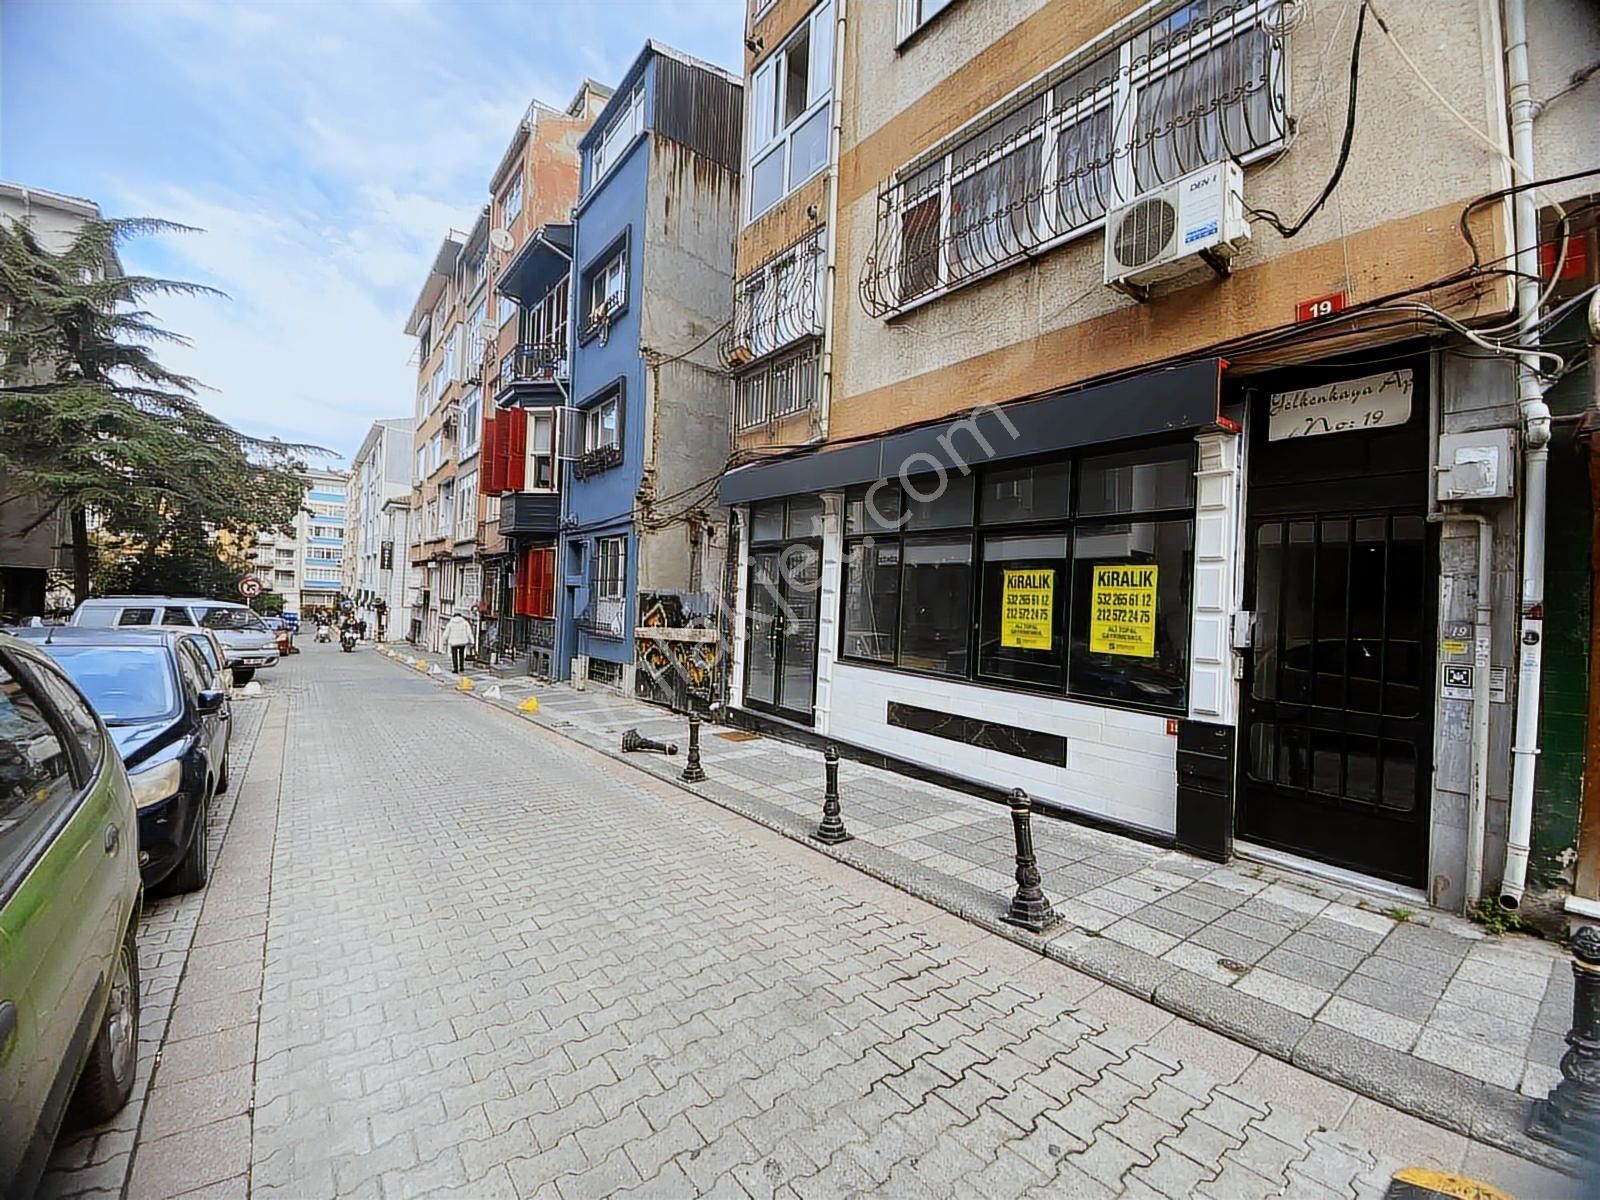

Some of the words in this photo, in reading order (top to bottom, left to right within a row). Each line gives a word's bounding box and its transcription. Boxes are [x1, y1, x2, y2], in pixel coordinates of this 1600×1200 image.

[1309, 300, 1332, 318] 19
[1269, 385, 1373, 416] Yelkenkaya
[1363, 409, 1385, 426] 19
[1097, 593, 1112, 606] 532
[1112, 593, 1128, 606] 265
[1142, 594, 1152, 607] 12
[1096, 608, 1111, 621] 212
[1112, 609, 1128, 622] 572
[1128, 610, 1139, 623] 24
[1140, 610, 1151, 624] 75
[1451, 626, 1468, 638] 19
